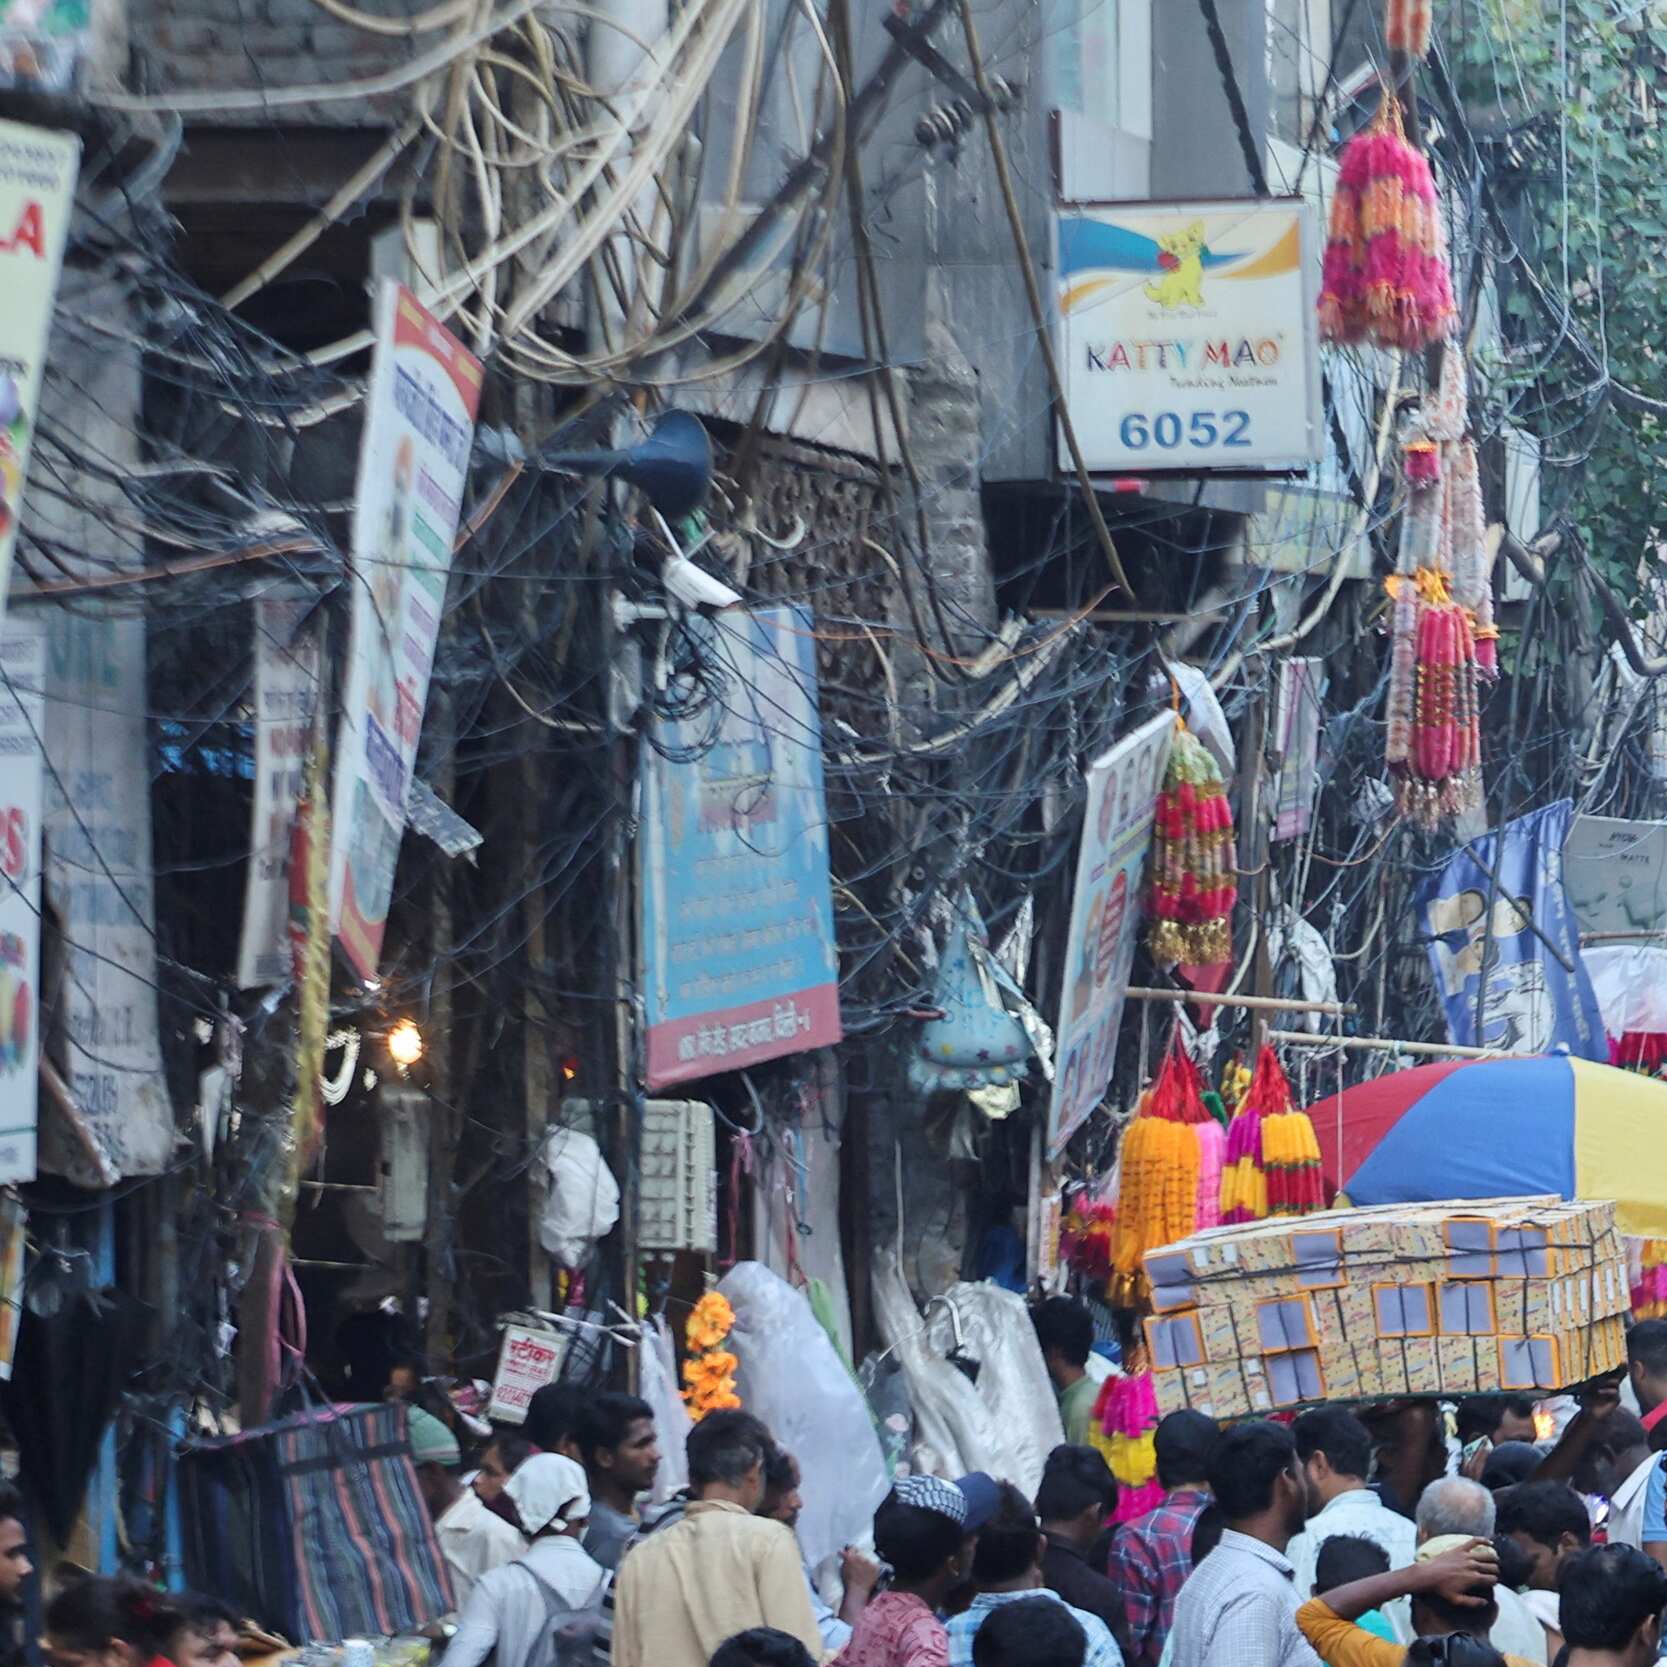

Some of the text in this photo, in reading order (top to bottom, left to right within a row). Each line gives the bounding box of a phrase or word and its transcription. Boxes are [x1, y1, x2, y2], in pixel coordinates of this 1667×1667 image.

[1086, 338, 1281, 371] KATTY MAO
[1119, 409, 1253, 450] 6052
